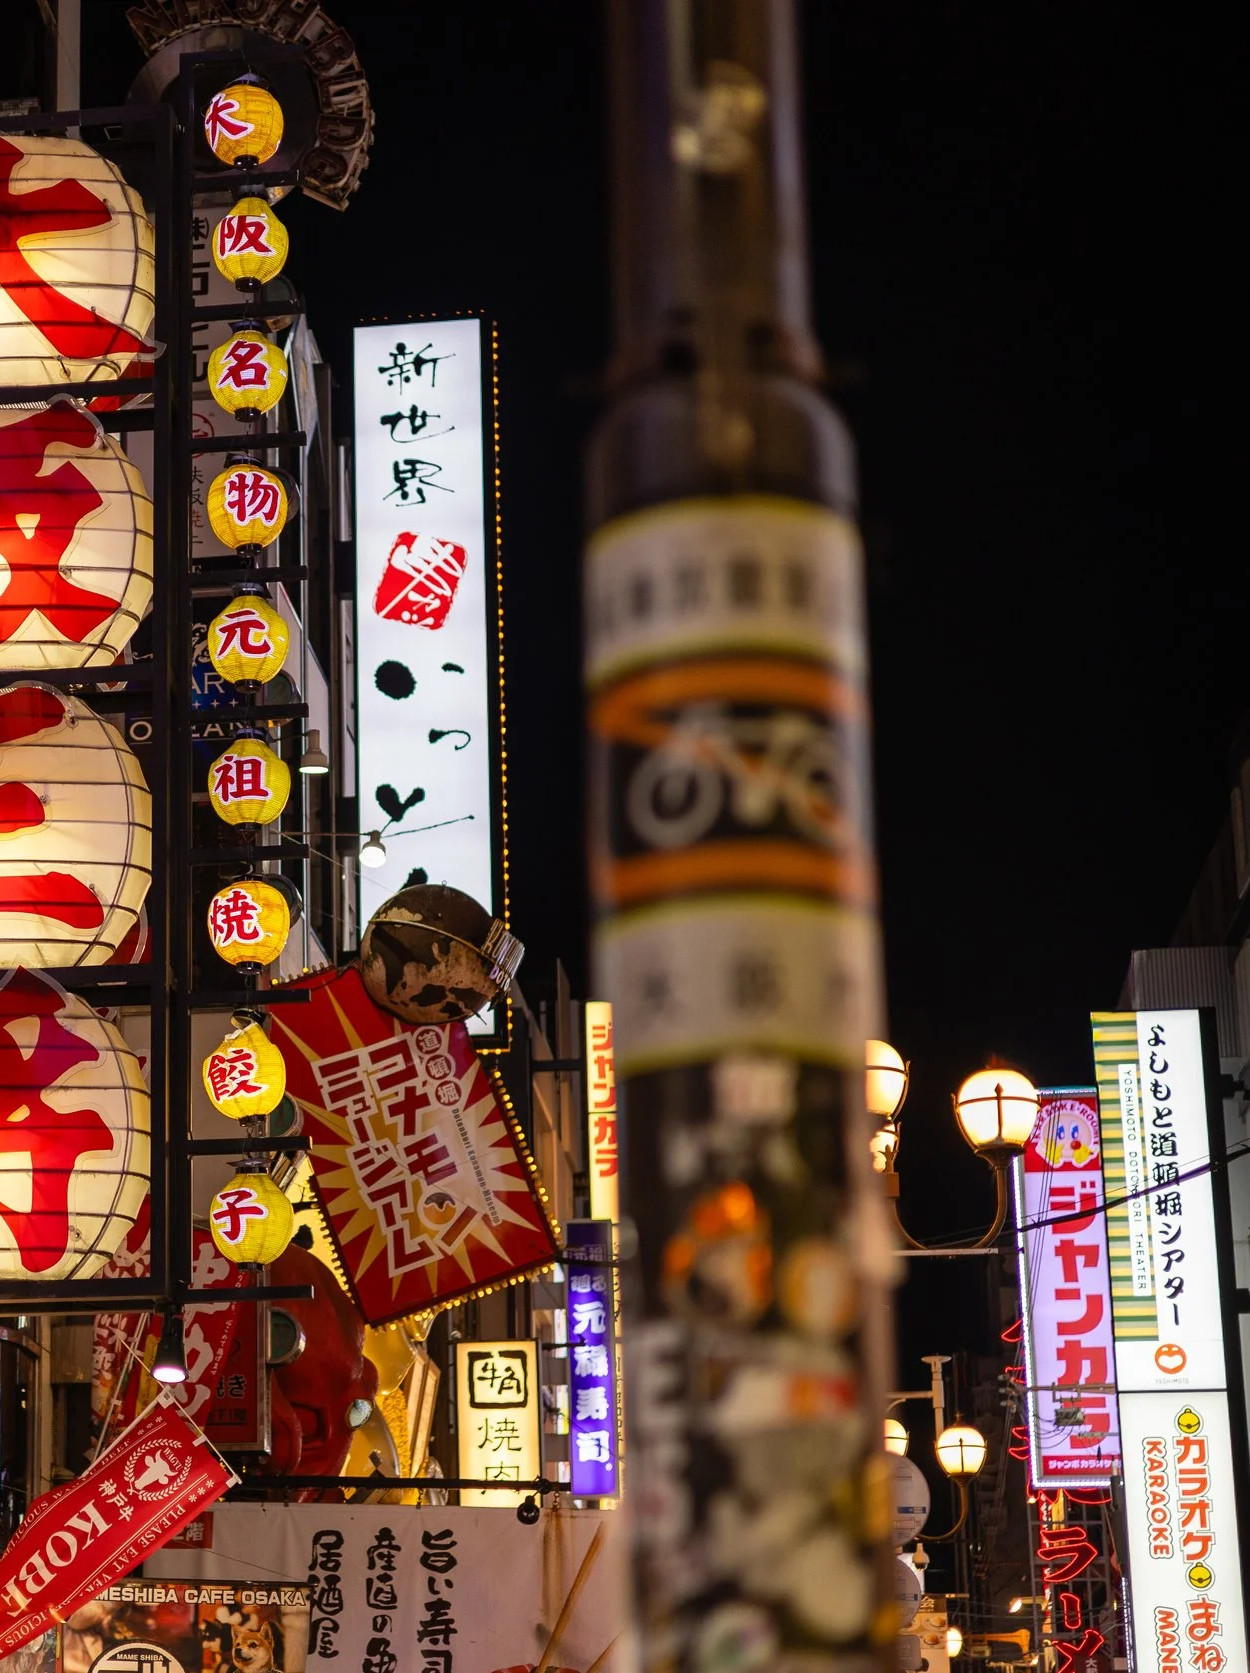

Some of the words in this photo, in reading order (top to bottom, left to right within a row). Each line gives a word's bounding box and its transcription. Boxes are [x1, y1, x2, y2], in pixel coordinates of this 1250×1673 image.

[377, 341, 456, 507] 新世界
[316, 1052, 435, 1270] ミュージアム
[1124, 1070, 1136, 1140] YOSHIMOTO
[1135, 1234, 1146, 1290] THEATER
[1147, 1025, 1186, 1326] よしもと道頓堀シアター
[477, 1362, 521, 1395] 牛角
[98, 1479, 134, 1522] 神戸牛
[137, 1504, 186, 1547] PLEASE
[1146, 1440, 1170, 1556] KARAOKE
[1175, 1436, 1213, 1561] カラオケ
[1, 1501, 112, 1617] KOBE
[112, 1543, 139, 1573] EAT
[184, 1588, 235, 1605] CAFE
[241, 1590, 306, 1606] OSAKA
[117, 1653, 139, 1661] MAME
[140, 1654, 164, 1662] SHIBA
